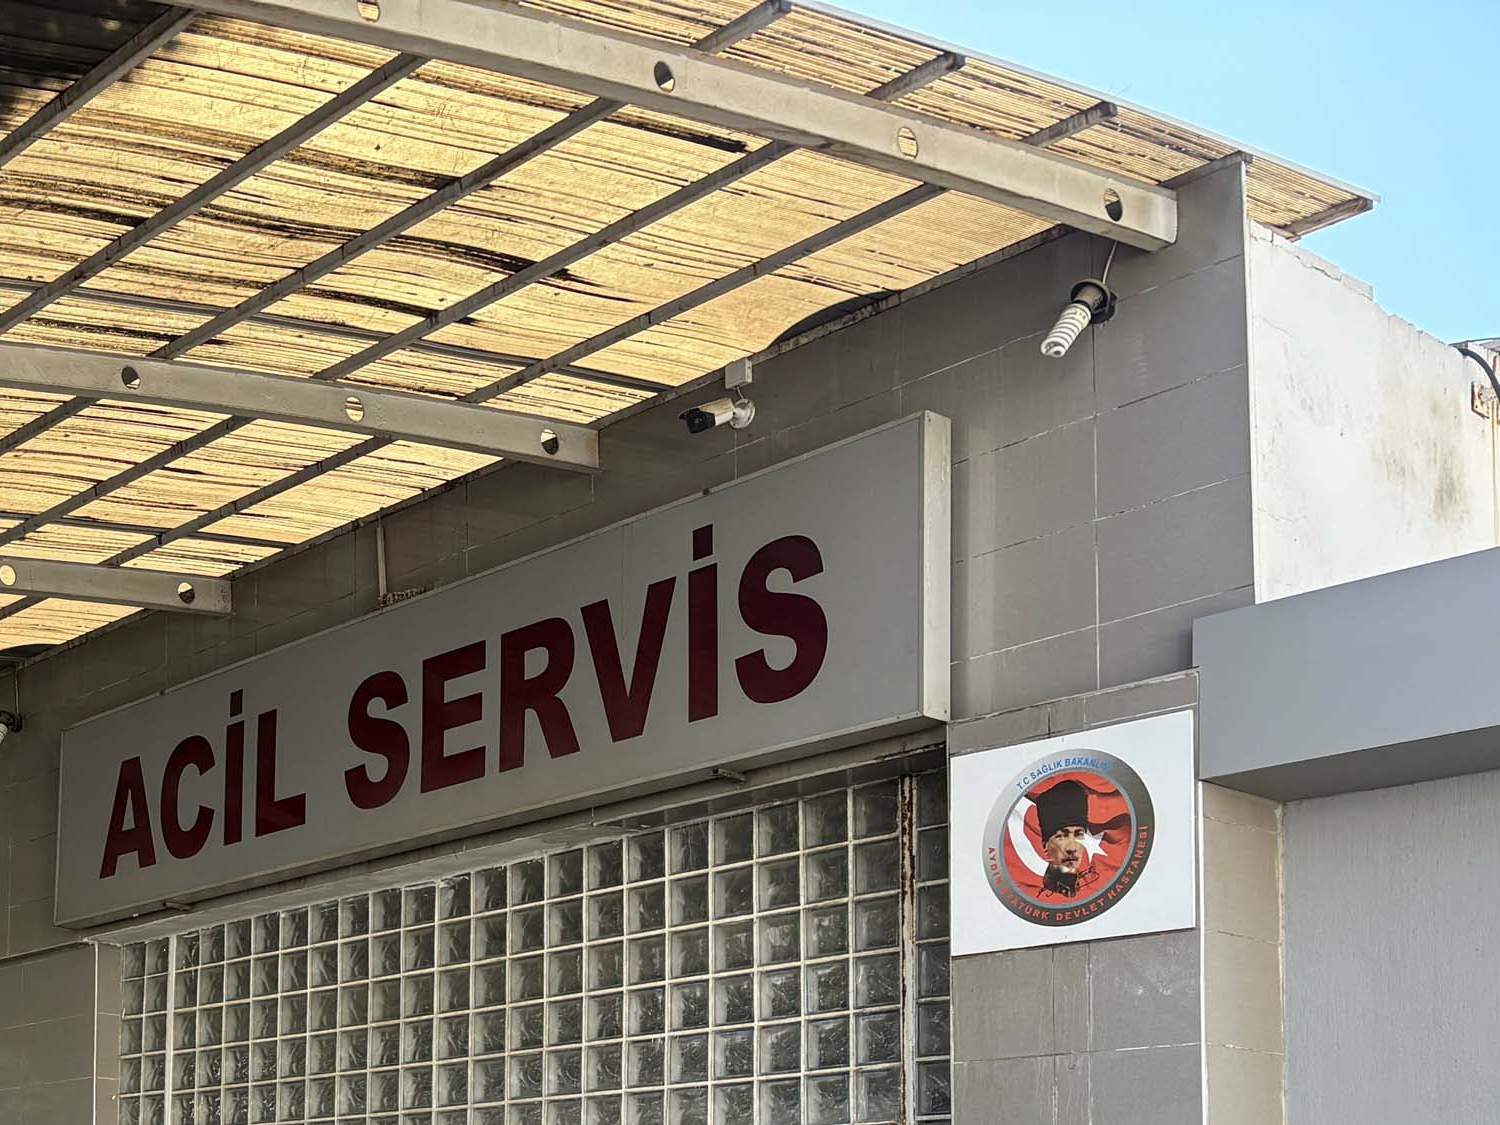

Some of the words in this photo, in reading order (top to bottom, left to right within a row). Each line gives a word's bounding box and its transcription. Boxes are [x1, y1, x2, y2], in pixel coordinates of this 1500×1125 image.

[100, 689, 306, 879] ACİL
[344, 523, 829, 811] SERVİS
[1030, 759, 1062, 780] SAĞLIK
[1056, 898, 1106, 921] DEVLET
